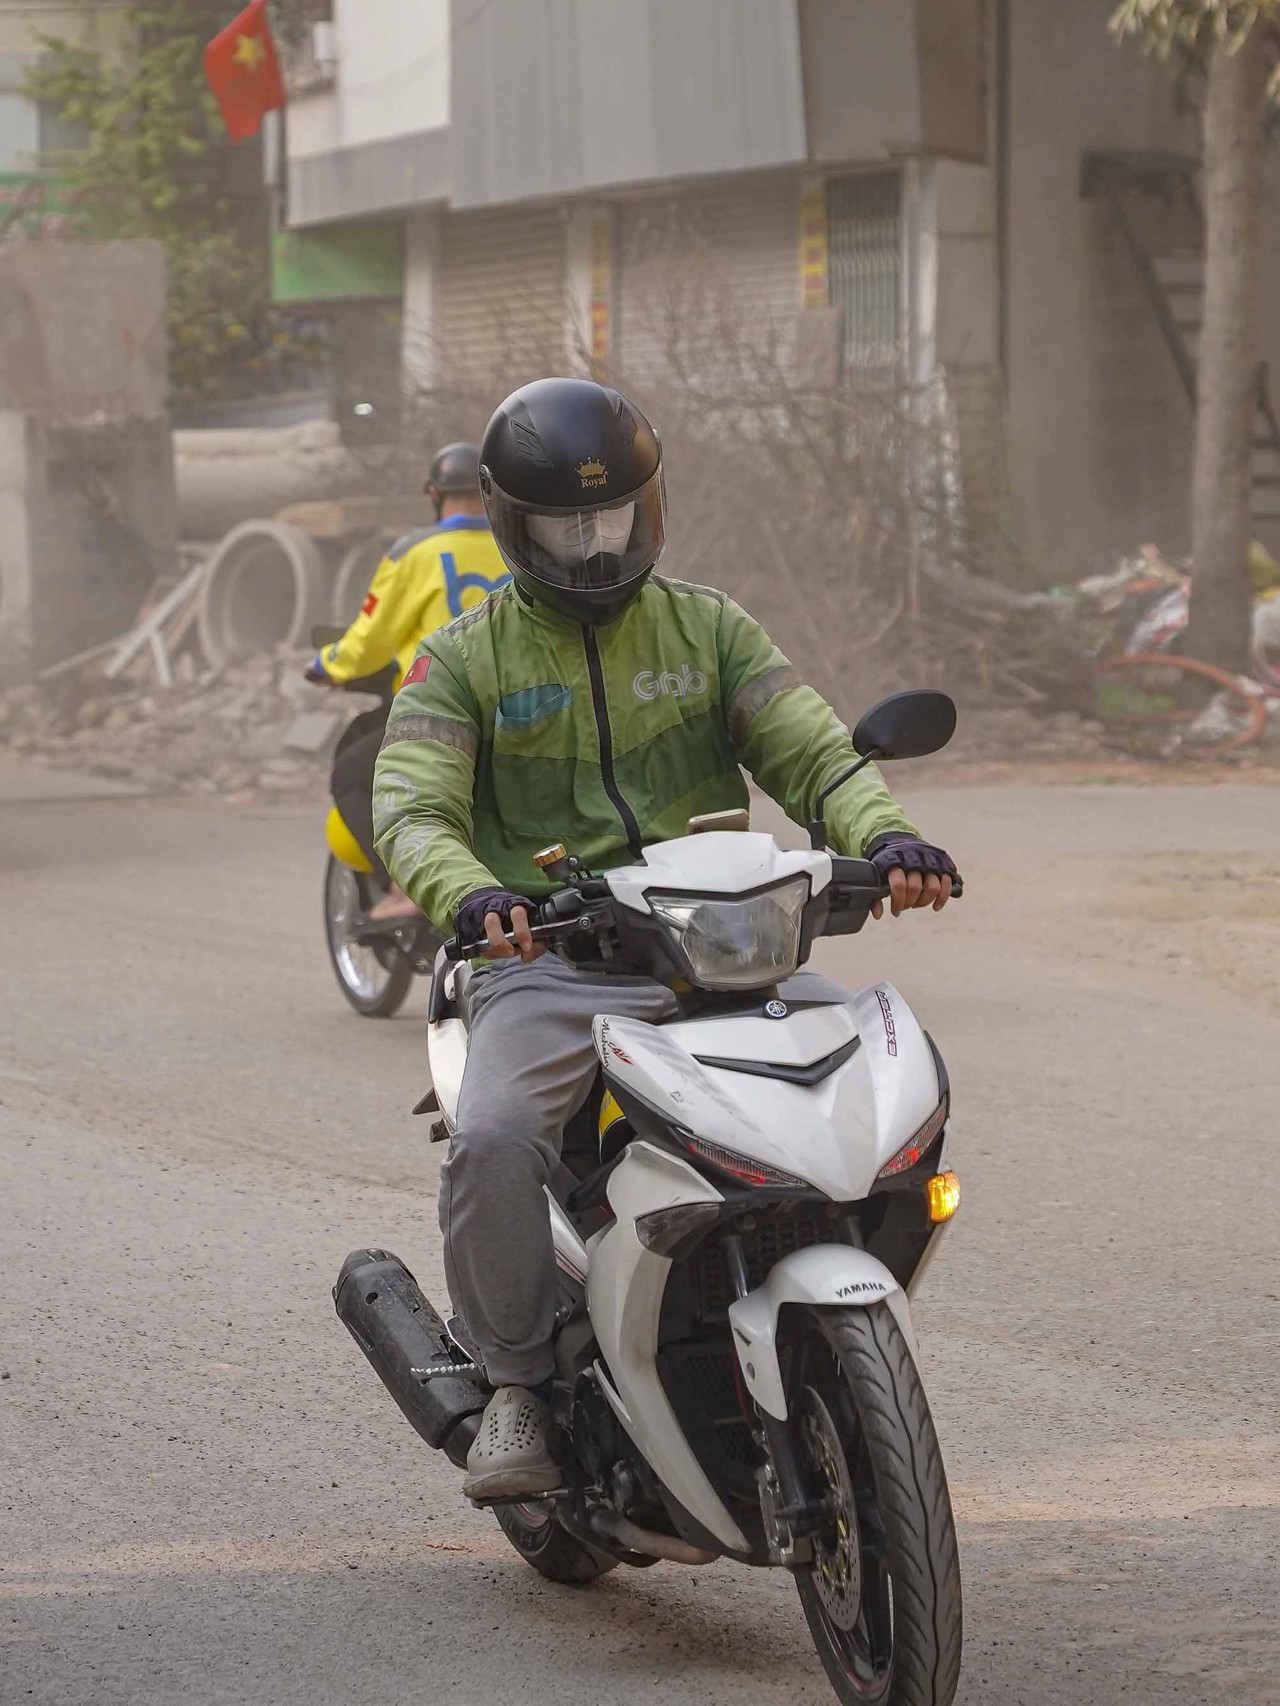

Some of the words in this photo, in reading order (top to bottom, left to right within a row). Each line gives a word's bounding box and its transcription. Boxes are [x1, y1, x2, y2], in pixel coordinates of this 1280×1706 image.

[581, 474, 607, 488] Royal
[875, 990, 897, 1057] EXCITER
[835, 1282, 886, 1298] YAMAHA
